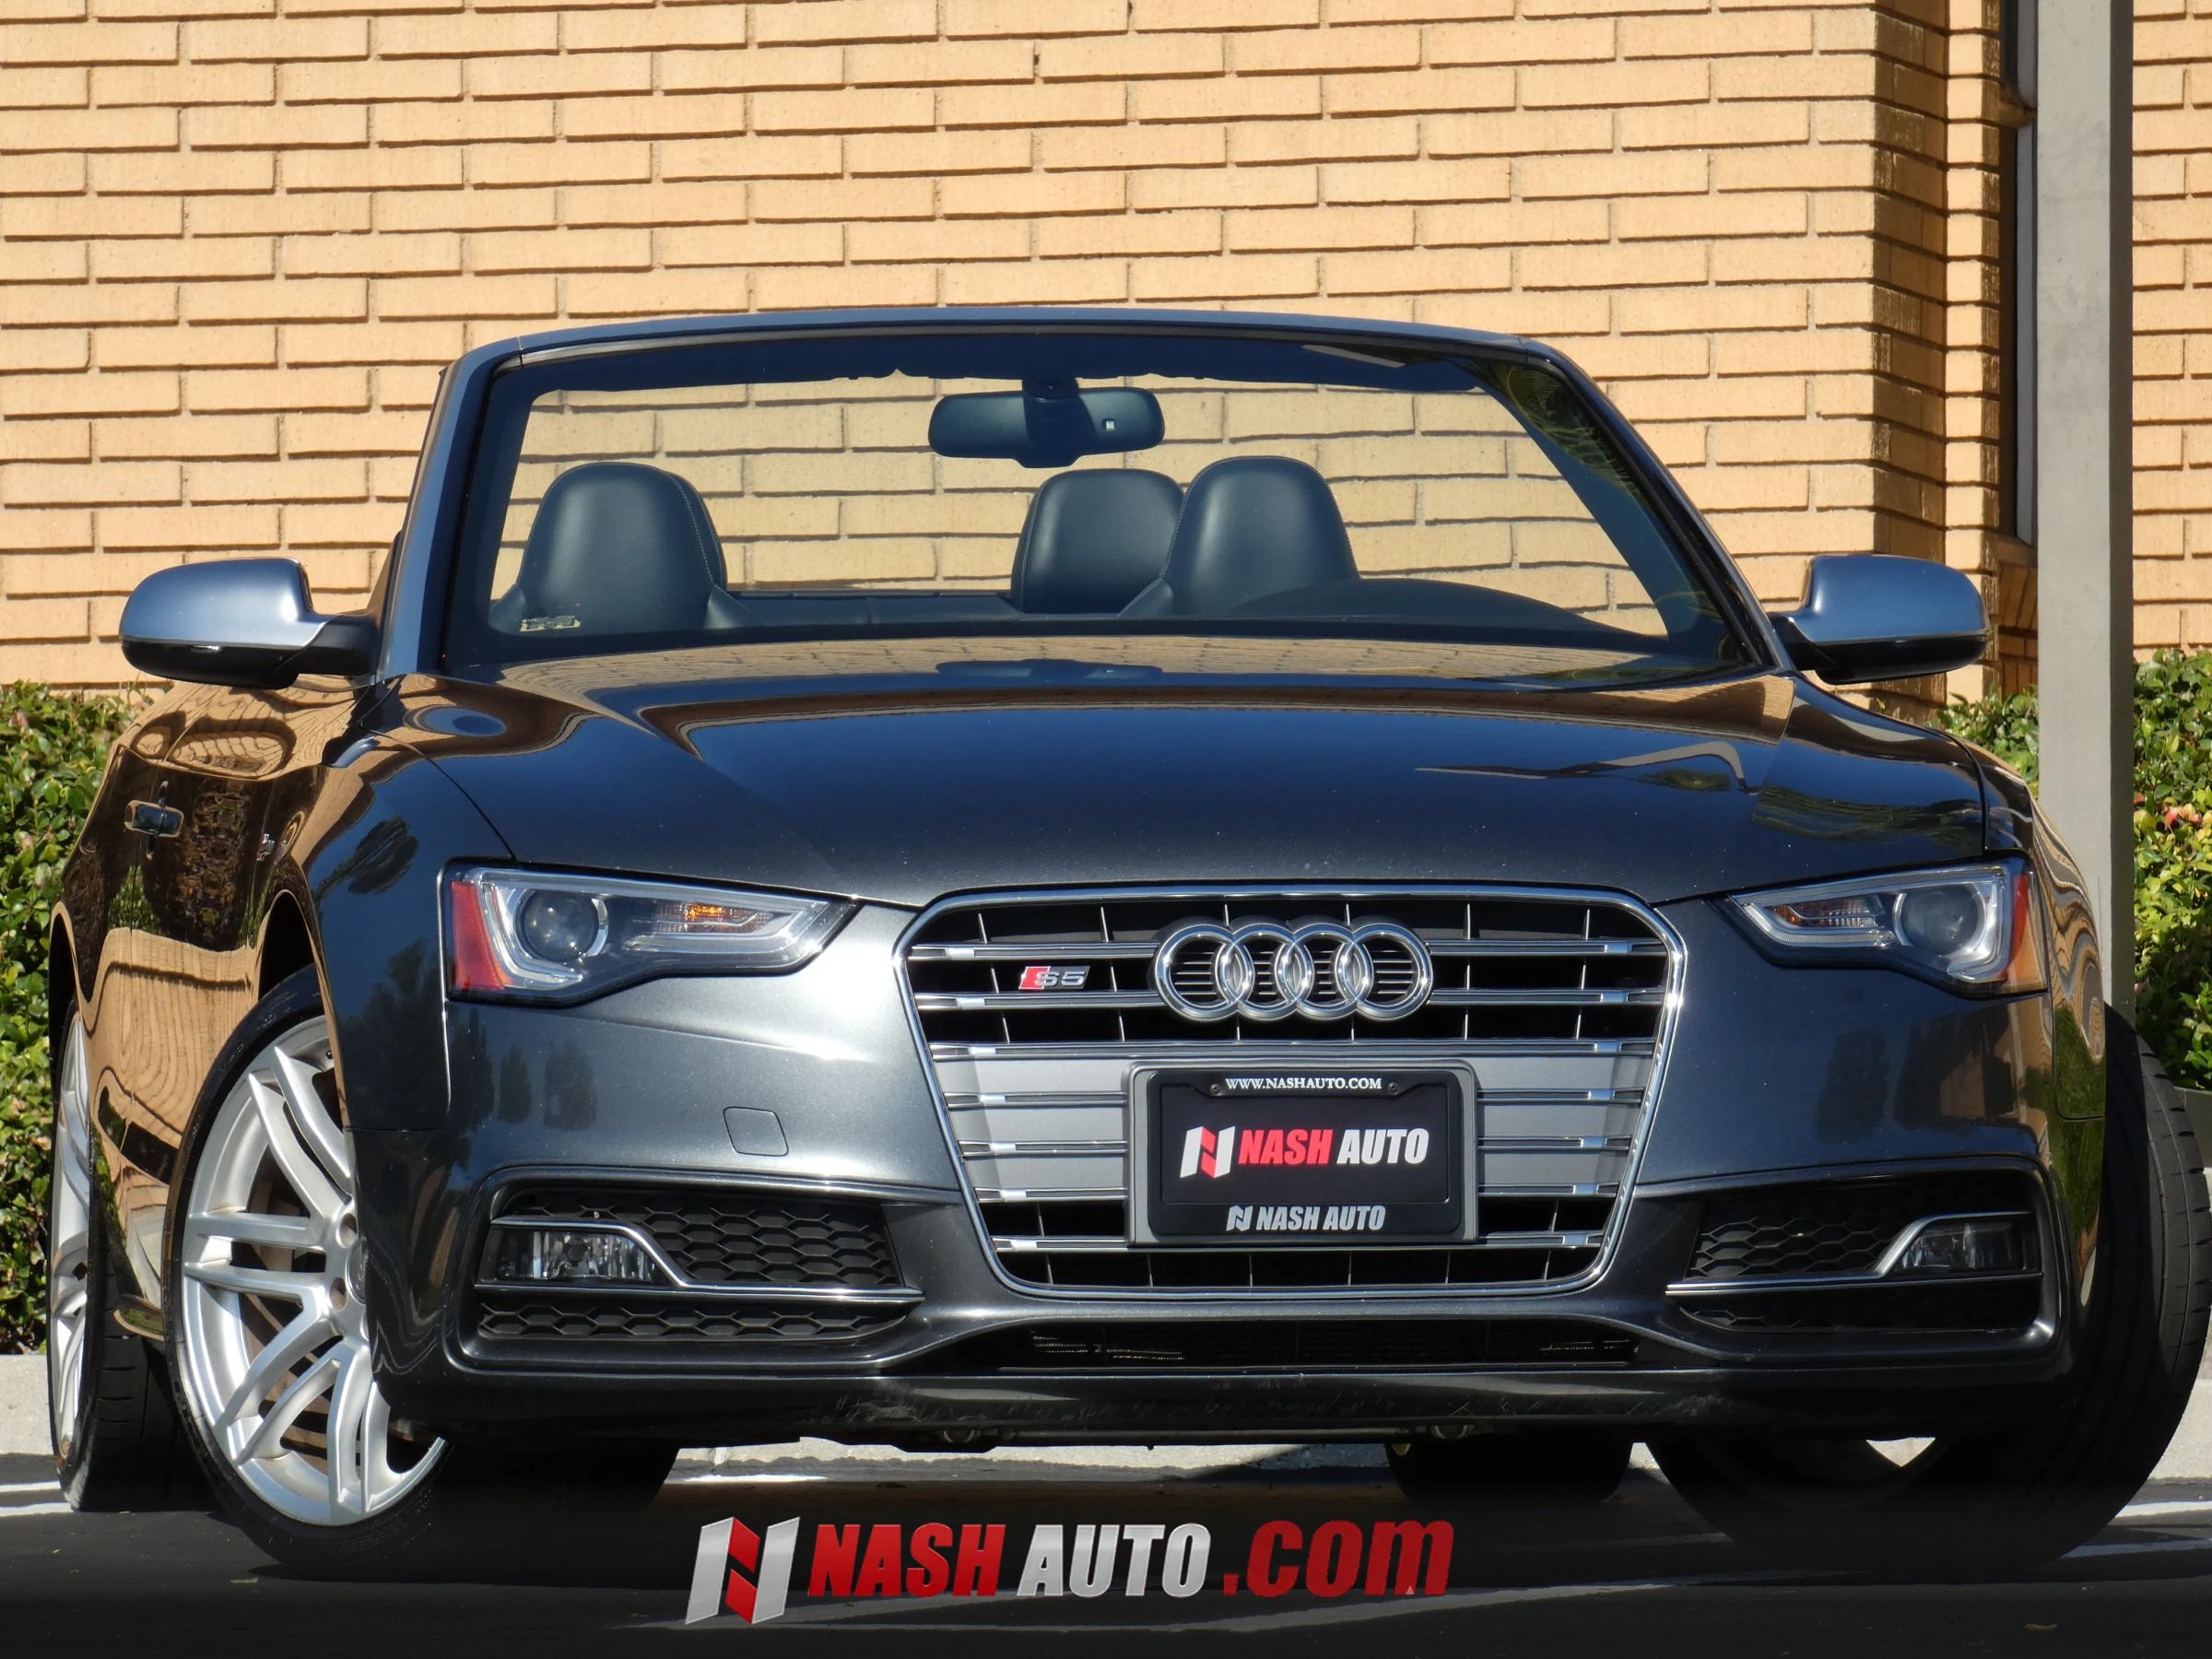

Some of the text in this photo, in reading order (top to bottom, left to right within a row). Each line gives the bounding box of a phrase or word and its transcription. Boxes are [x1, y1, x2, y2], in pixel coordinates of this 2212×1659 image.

[1033, 971, 1086, 987] S5
[1225, 1077, 1382, 1089] WWW.NASHAUTO.COM
[1238, 1128, 1334, 1165] NASH
[1336, 1128, 1430, 1165] AUTO
[1256, 1206, 1321, 1230] NASH
[1324, 1205, 1386, 1230] AUTO
